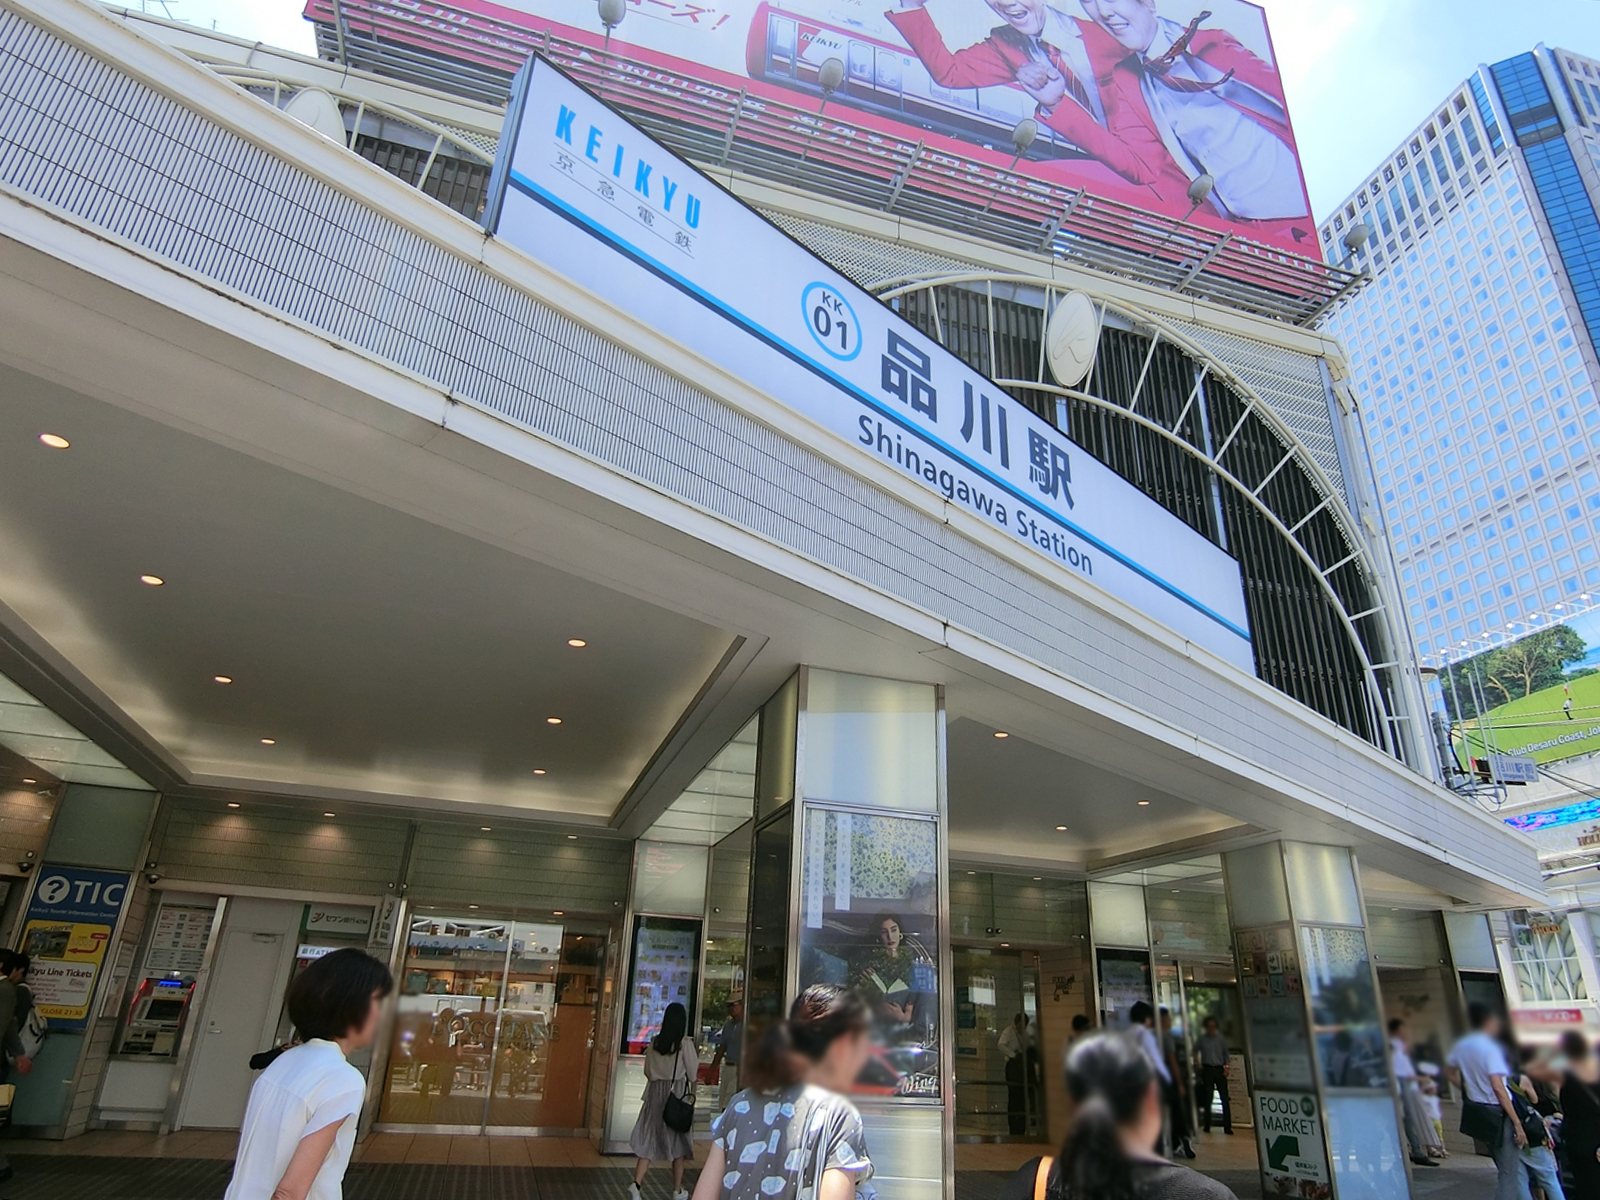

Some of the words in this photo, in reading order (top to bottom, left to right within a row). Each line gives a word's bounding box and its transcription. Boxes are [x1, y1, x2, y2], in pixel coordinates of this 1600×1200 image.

[802, 33, 842, 50] KEIKYU
[555, 103, 702, 231] KEIKYU
[554, 153, 693, 254] 京急電鉄
[821, 290, 843, 316] KK
[813, 304, 848, 351] 01
[881, 328, 1074, 510] 品川駅
[858, 413, 1007, 526] Shinagawa
[1017, 510, 1093, 576] Station
[1527, 739, 1558, 752] Desaru
[1558, 730, 1587, 744] Coast,
[74, 880, 125, 907] TIC
[27, 966, 46, 977] ikyu
[47, 967, 65, 977] Line
[66, 968, 93, 979] Tickets
[1260, 1096, 1299, 1115] FOOD
[1262, 1114, 1316, 1136] MARKET
